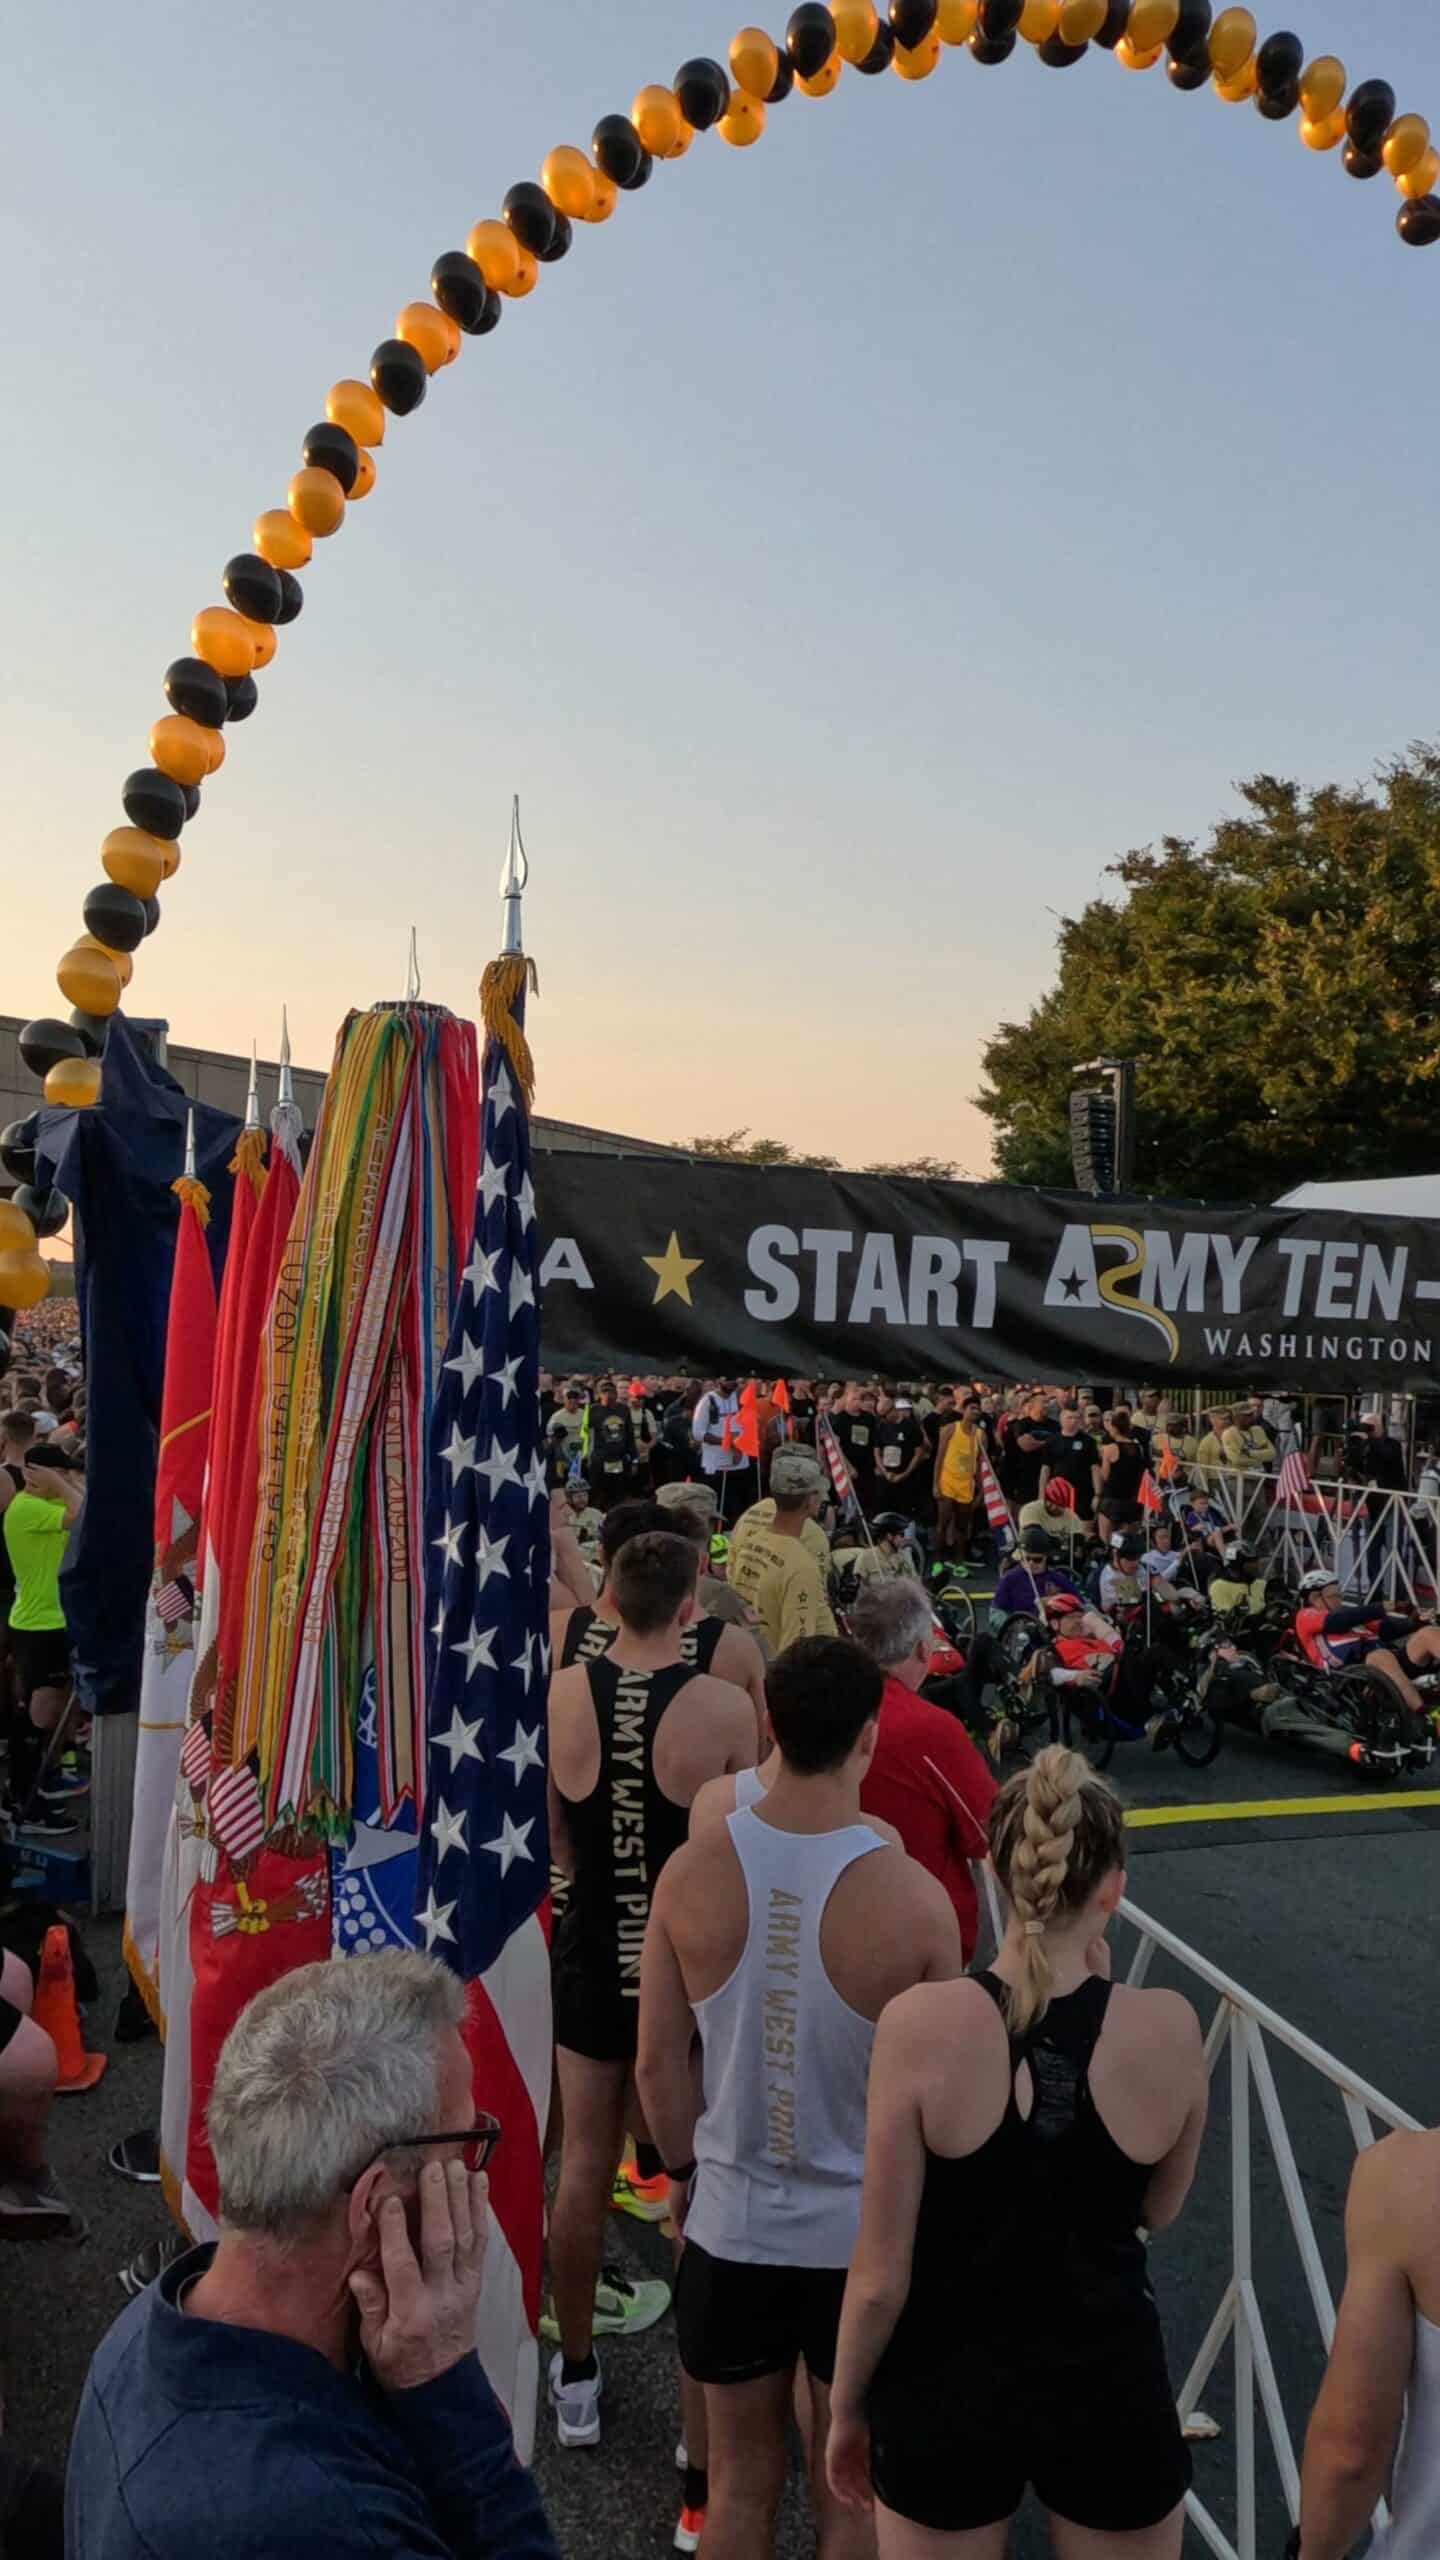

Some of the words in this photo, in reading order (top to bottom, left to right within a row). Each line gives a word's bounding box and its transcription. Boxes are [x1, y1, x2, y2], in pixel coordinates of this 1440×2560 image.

[744, 1224, 1010, 1328] START
[1043, 1223, 1260, 1361] ARMY
[1203, 1328, 1433, 1362] WASHINGTON
[611, 1669, 654, 1770] ARMY
[611, 1779, 647, 1882] WEST
[765, 1887, 803, 1979] ARMY
[764, 1988, 798, 2077] WEST
